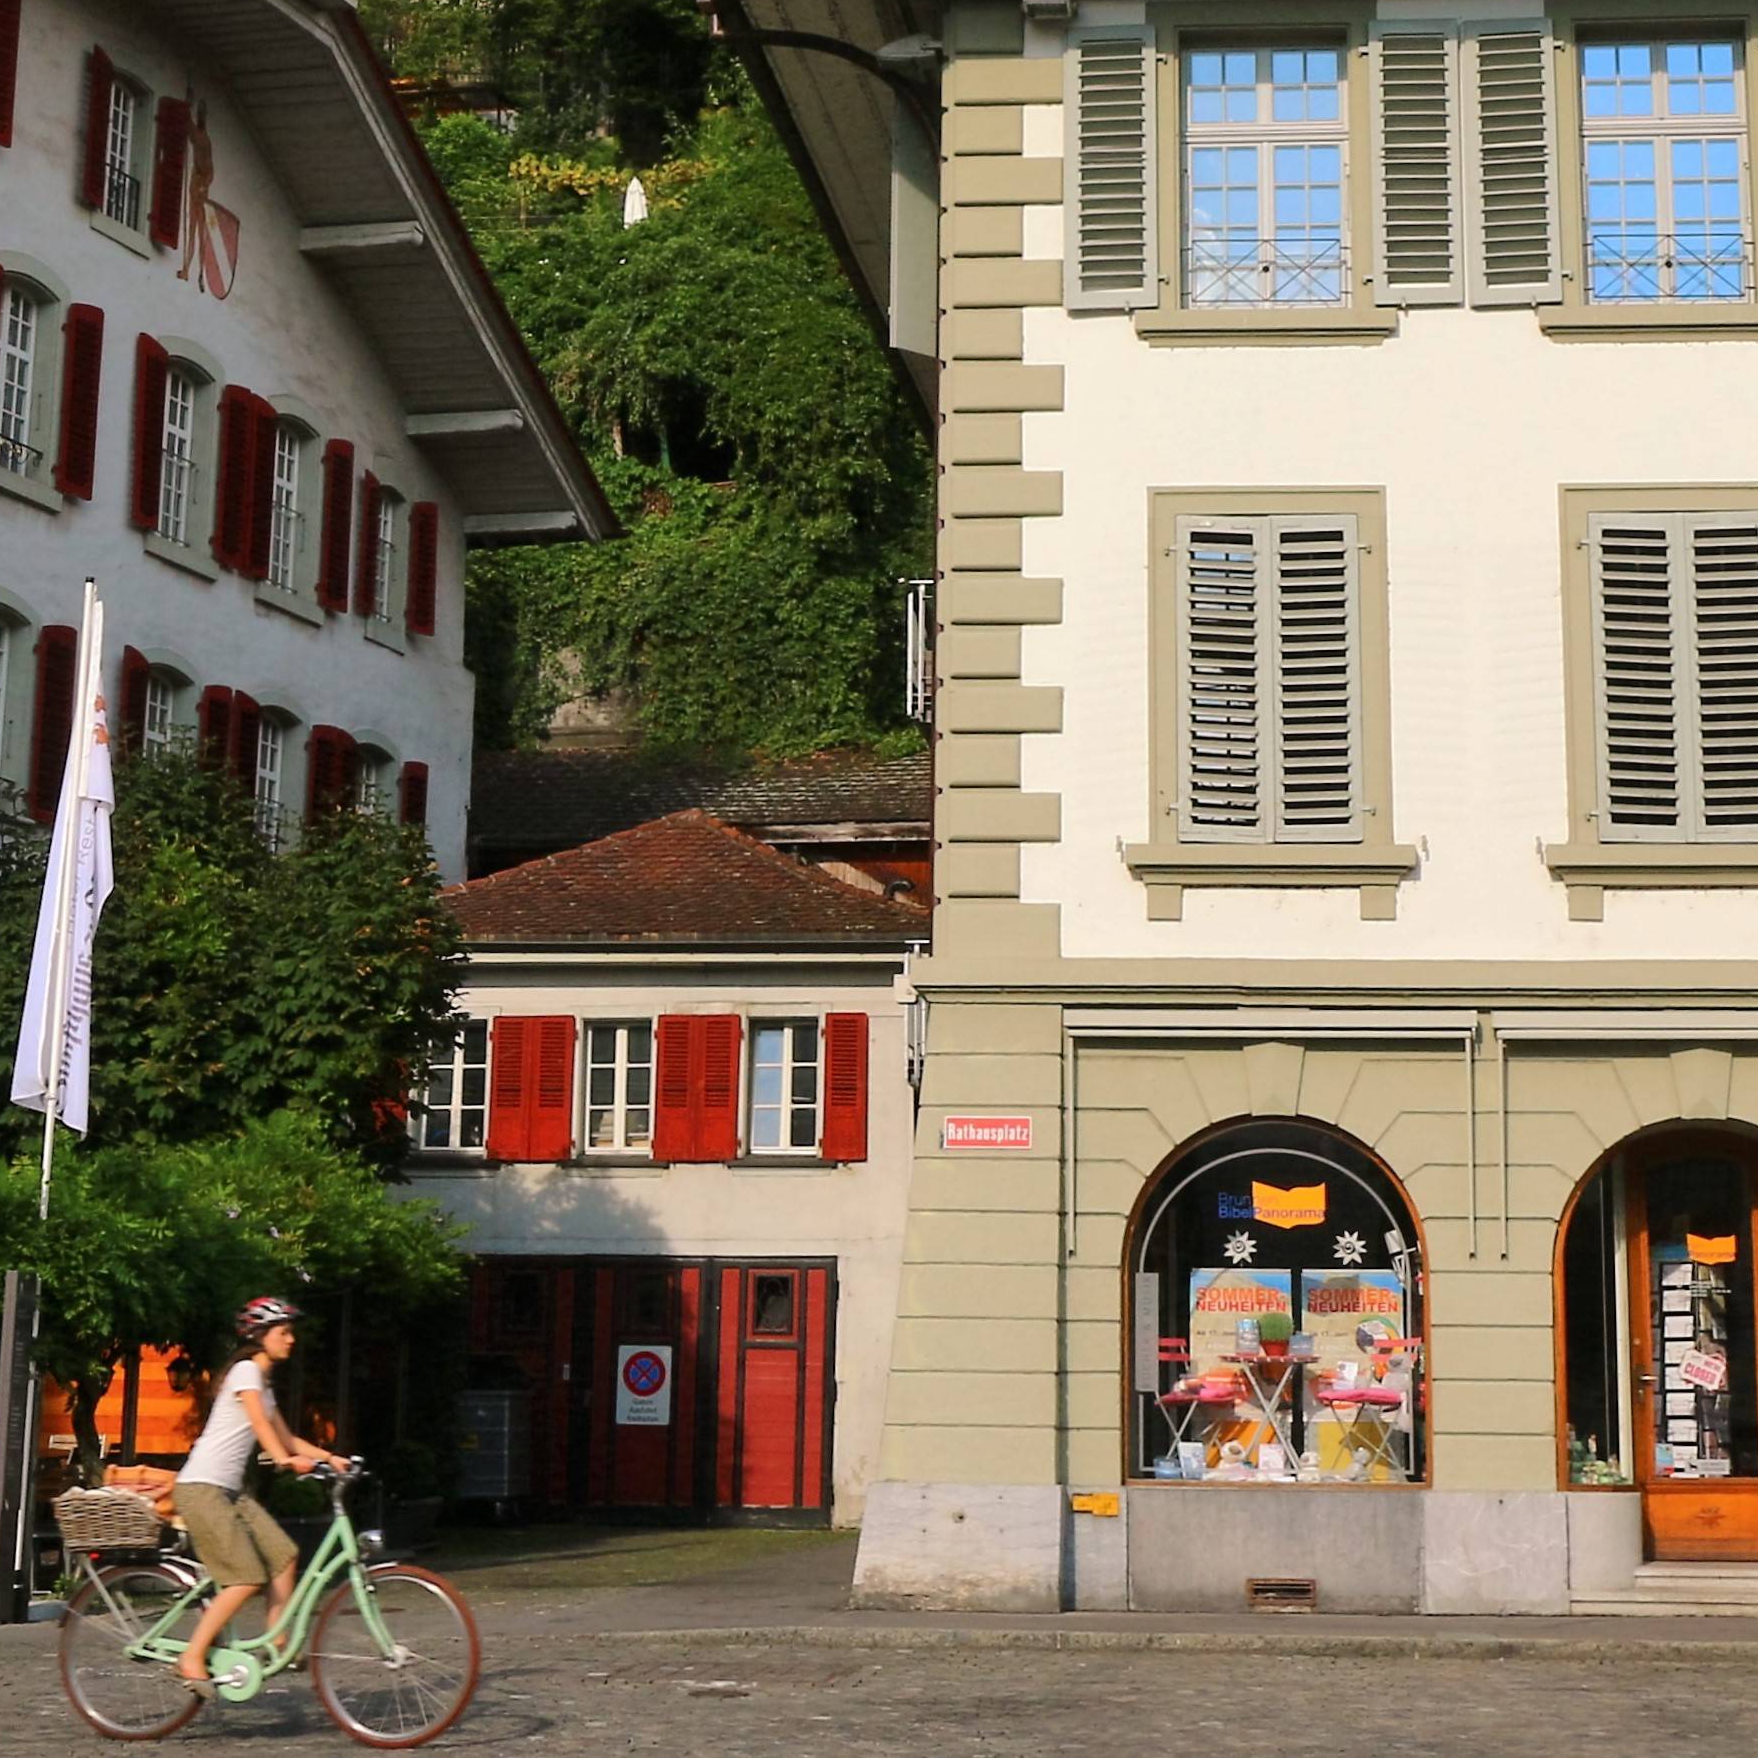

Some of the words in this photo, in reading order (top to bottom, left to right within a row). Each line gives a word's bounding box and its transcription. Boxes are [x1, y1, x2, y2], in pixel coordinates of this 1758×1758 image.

[948, 1123, 1029, 1144] Rathausplatz
[1197, 1287, 1286, 1302] SOMMER-
[1308, 1287, 1397, 1302] SOMMER-
[1197, 1301, 1287, 1312] NEUHEITEN
[1308, 1302, 1398, 1313] NEUHEITEN
